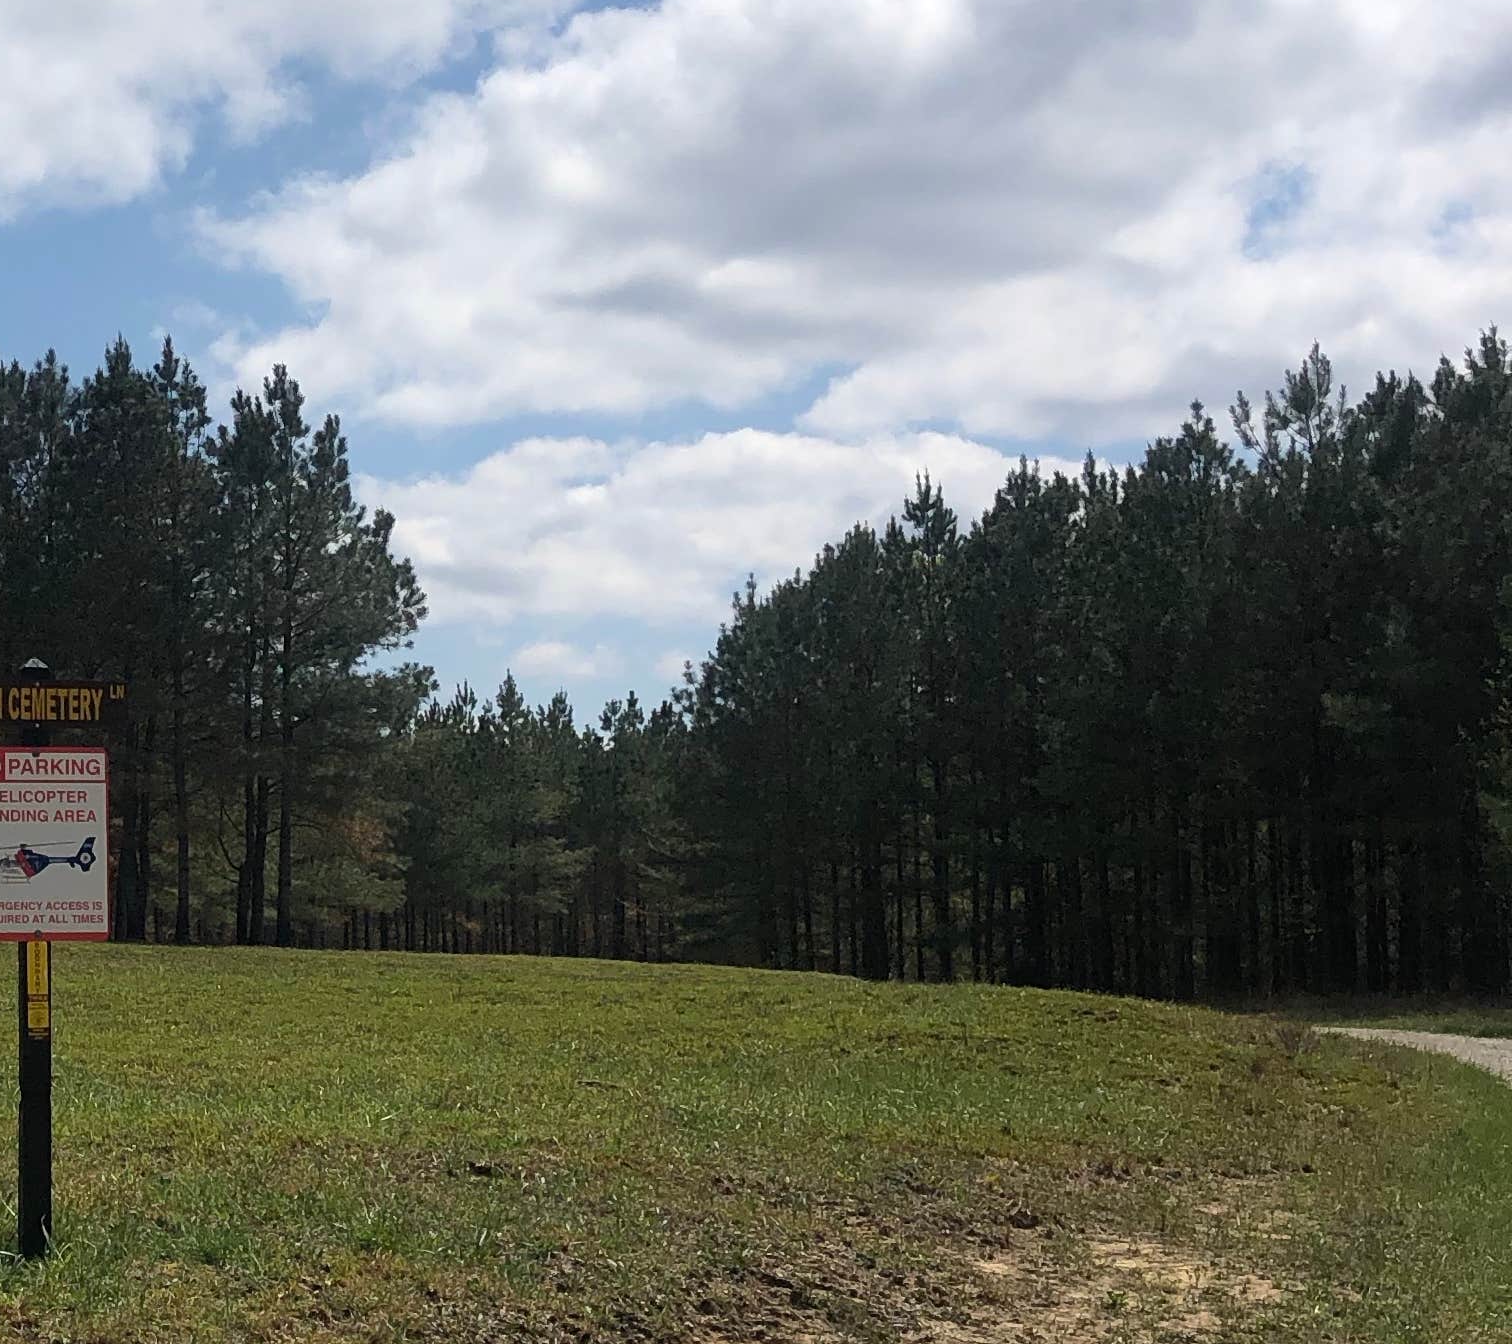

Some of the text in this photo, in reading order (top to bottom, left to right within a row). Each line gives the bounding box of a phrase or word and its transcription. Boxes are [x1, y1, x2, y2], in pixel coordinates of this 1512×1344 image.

[8, 687, 103, 721] CEMETERY
[109, 684, 125, 699] LN
[8, 758, 101, 775] PARKING
[53, 810, 97, 822] AREA
[45, 901, 90, 911] ACCESS
[92, 901, 103, 911] IS
[32, 915, 46, 924] AT
[48, 915, 68, 924] ALL
[72, 915, 104, 924] TIMES
